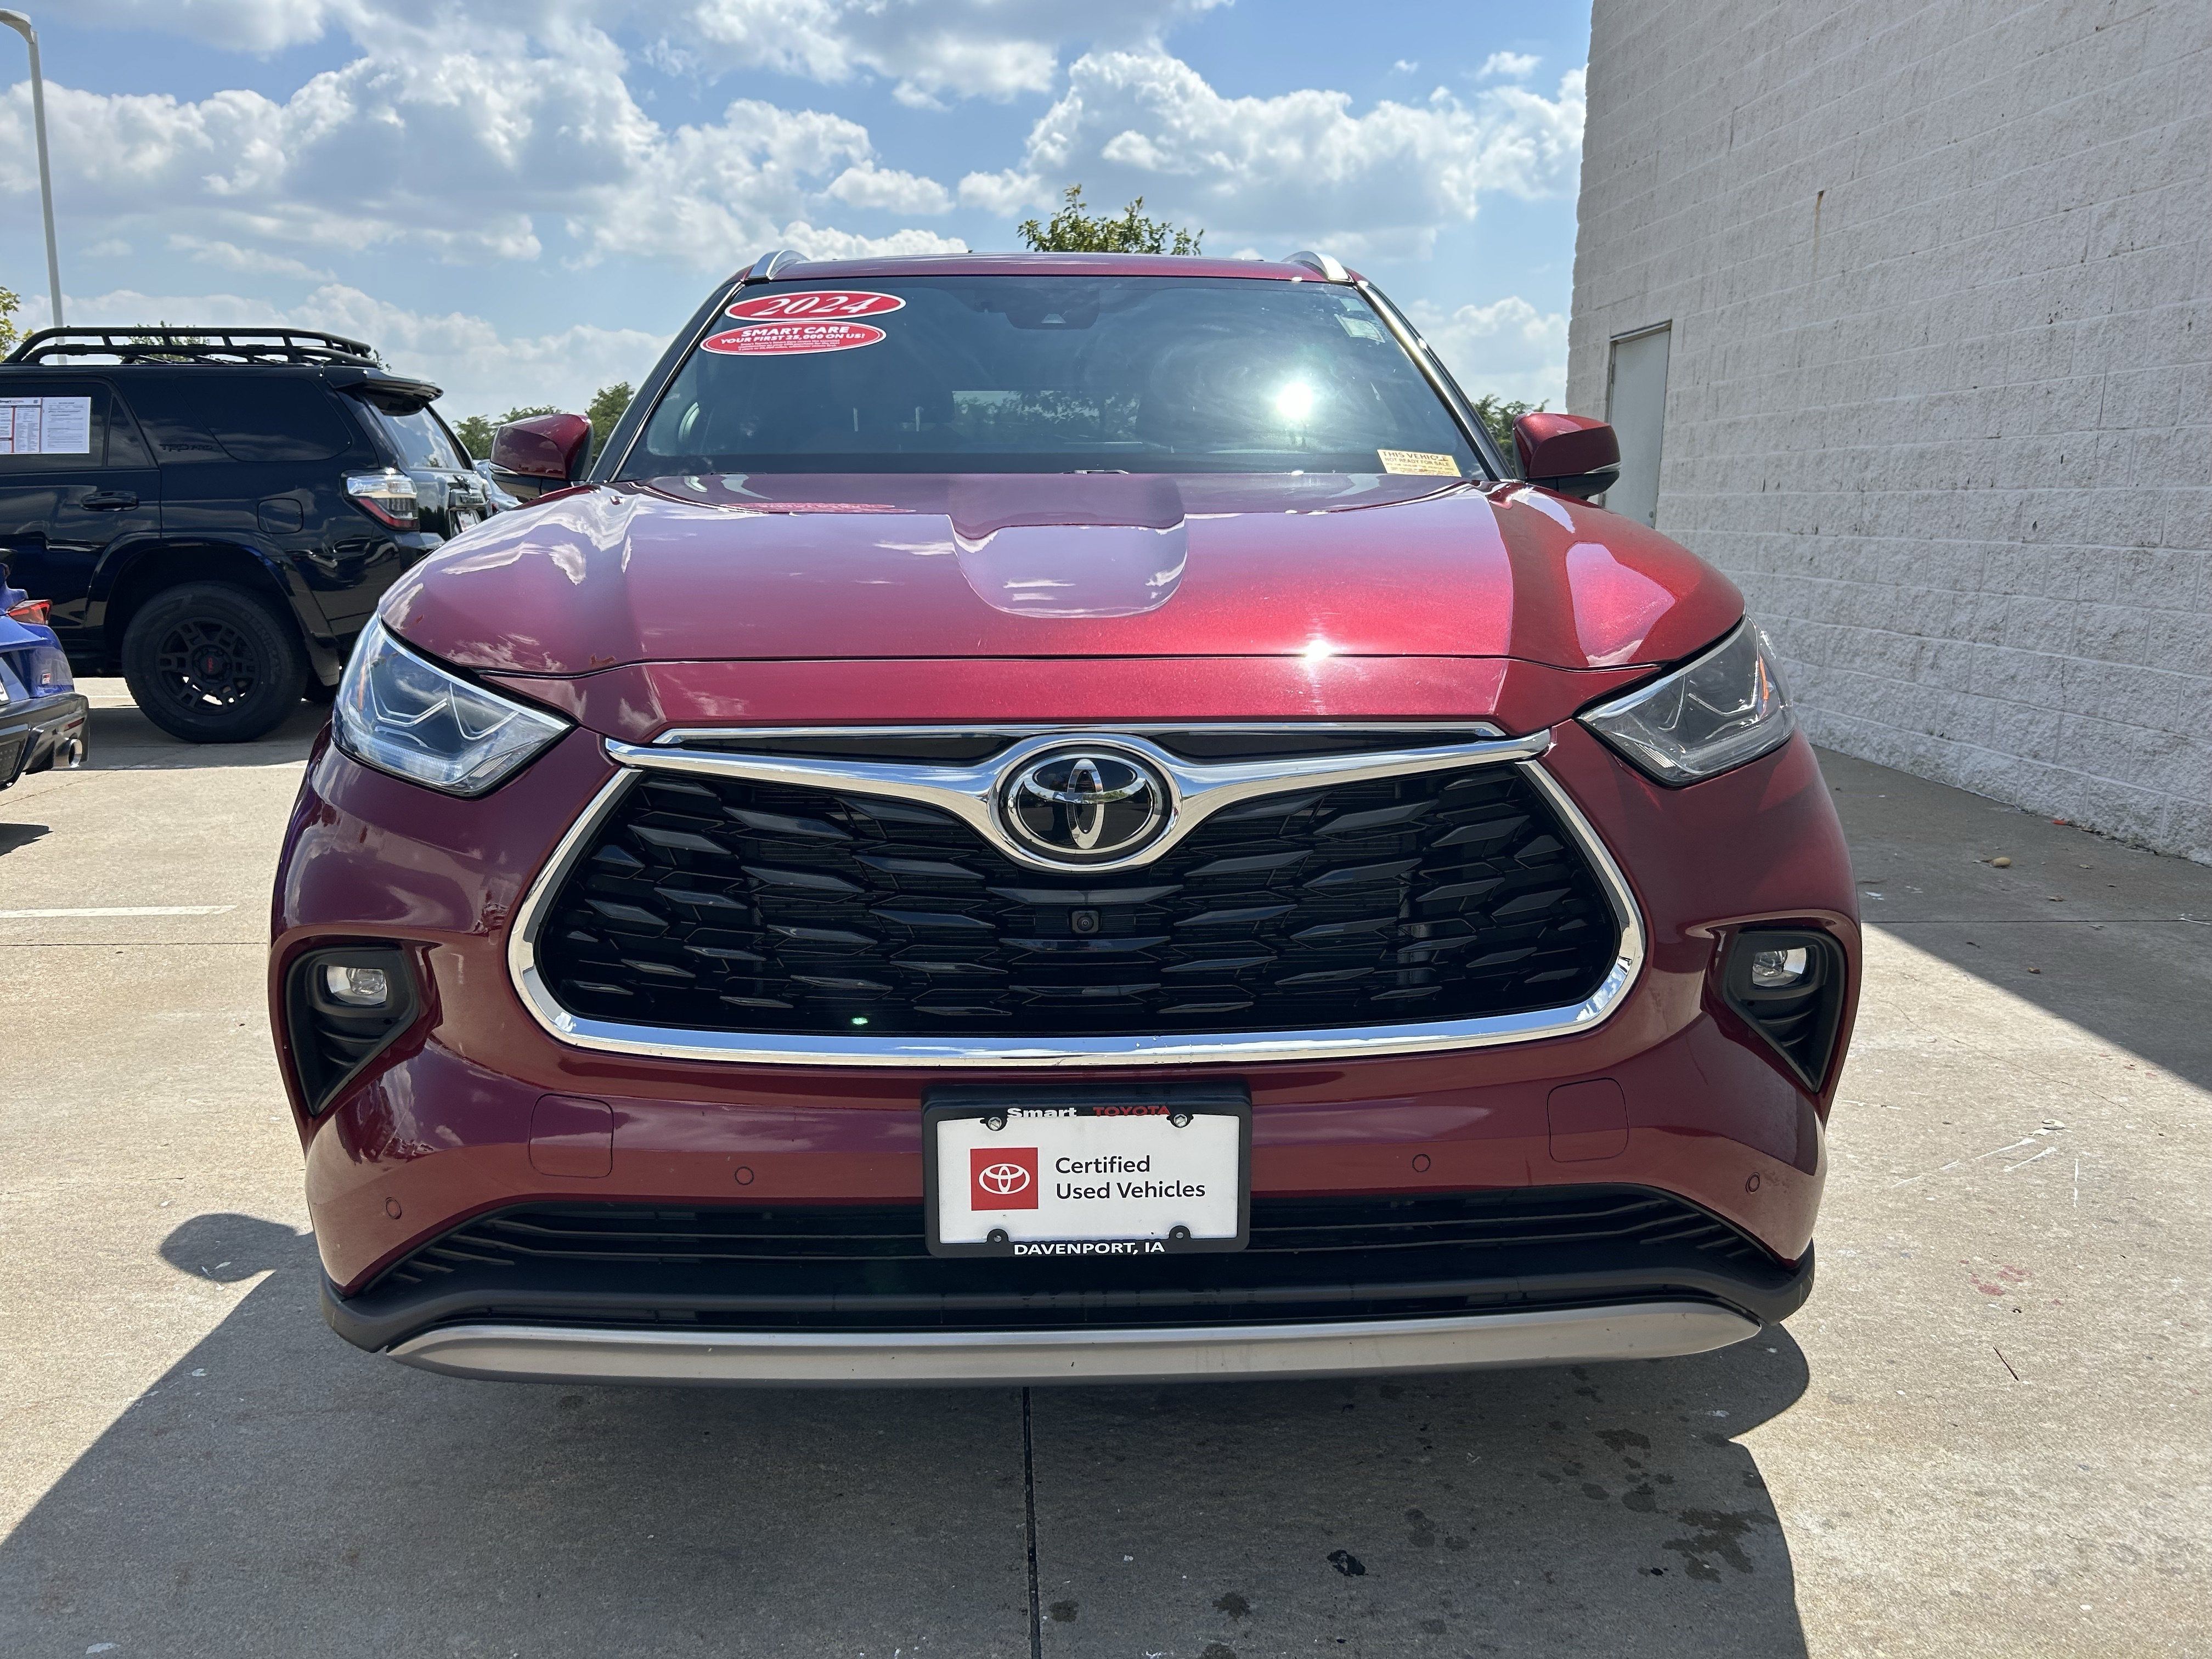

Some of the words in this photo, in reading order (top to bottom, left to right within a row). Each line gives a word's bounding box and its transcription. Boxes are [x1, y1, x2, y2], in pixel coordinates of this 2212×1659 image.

[750, 296, 882, 316] 2024
[741, 327, 802, 337] SMART
[1007, 1107, 1077, 1118] Smart
[1093, 1105, 1171, 1116] TOYOTA
[1056, 1155, 1150, 1173] Certified
[1057, 1182, 1110, 1199] Used
[1116, 1180, 1206, 1198] Vehicles
[1014, 1243, 1139, 1255] DAVENPORT,
[1145, 1242, 1165, 1252] IA
